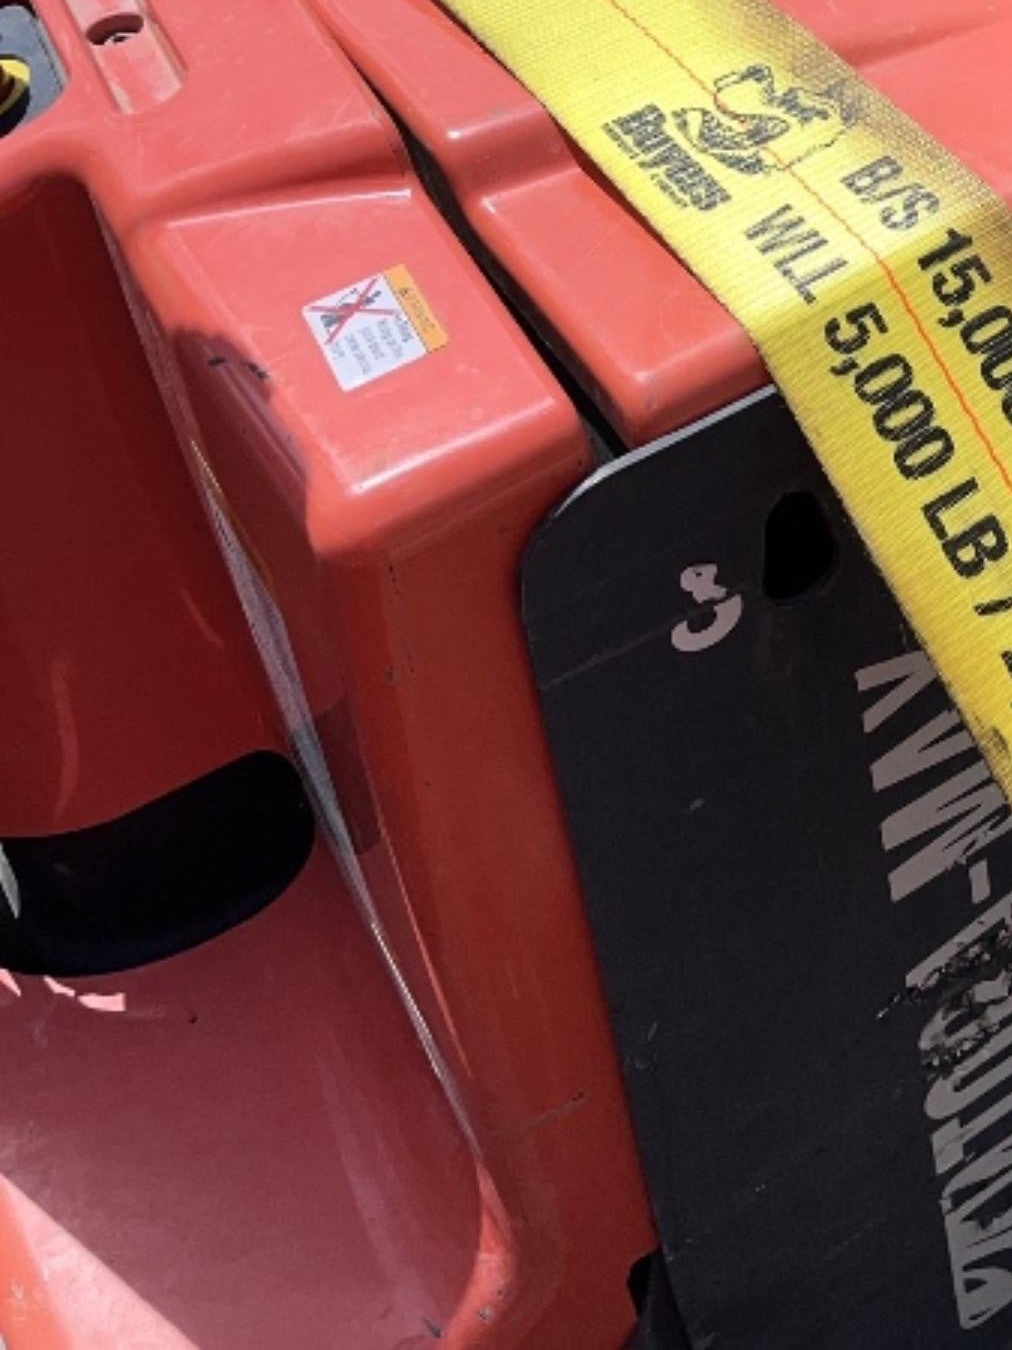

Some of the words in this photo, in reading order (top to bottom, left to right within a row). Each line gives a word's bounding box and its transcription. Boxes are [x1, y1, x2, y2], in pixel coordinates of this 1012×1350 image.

[842, 153, 941, 233] B/S
[743, 202, 849, 306] WLL
[823, 301, 957, 482] 5,000
[920, 476, 1011, 580] LB
